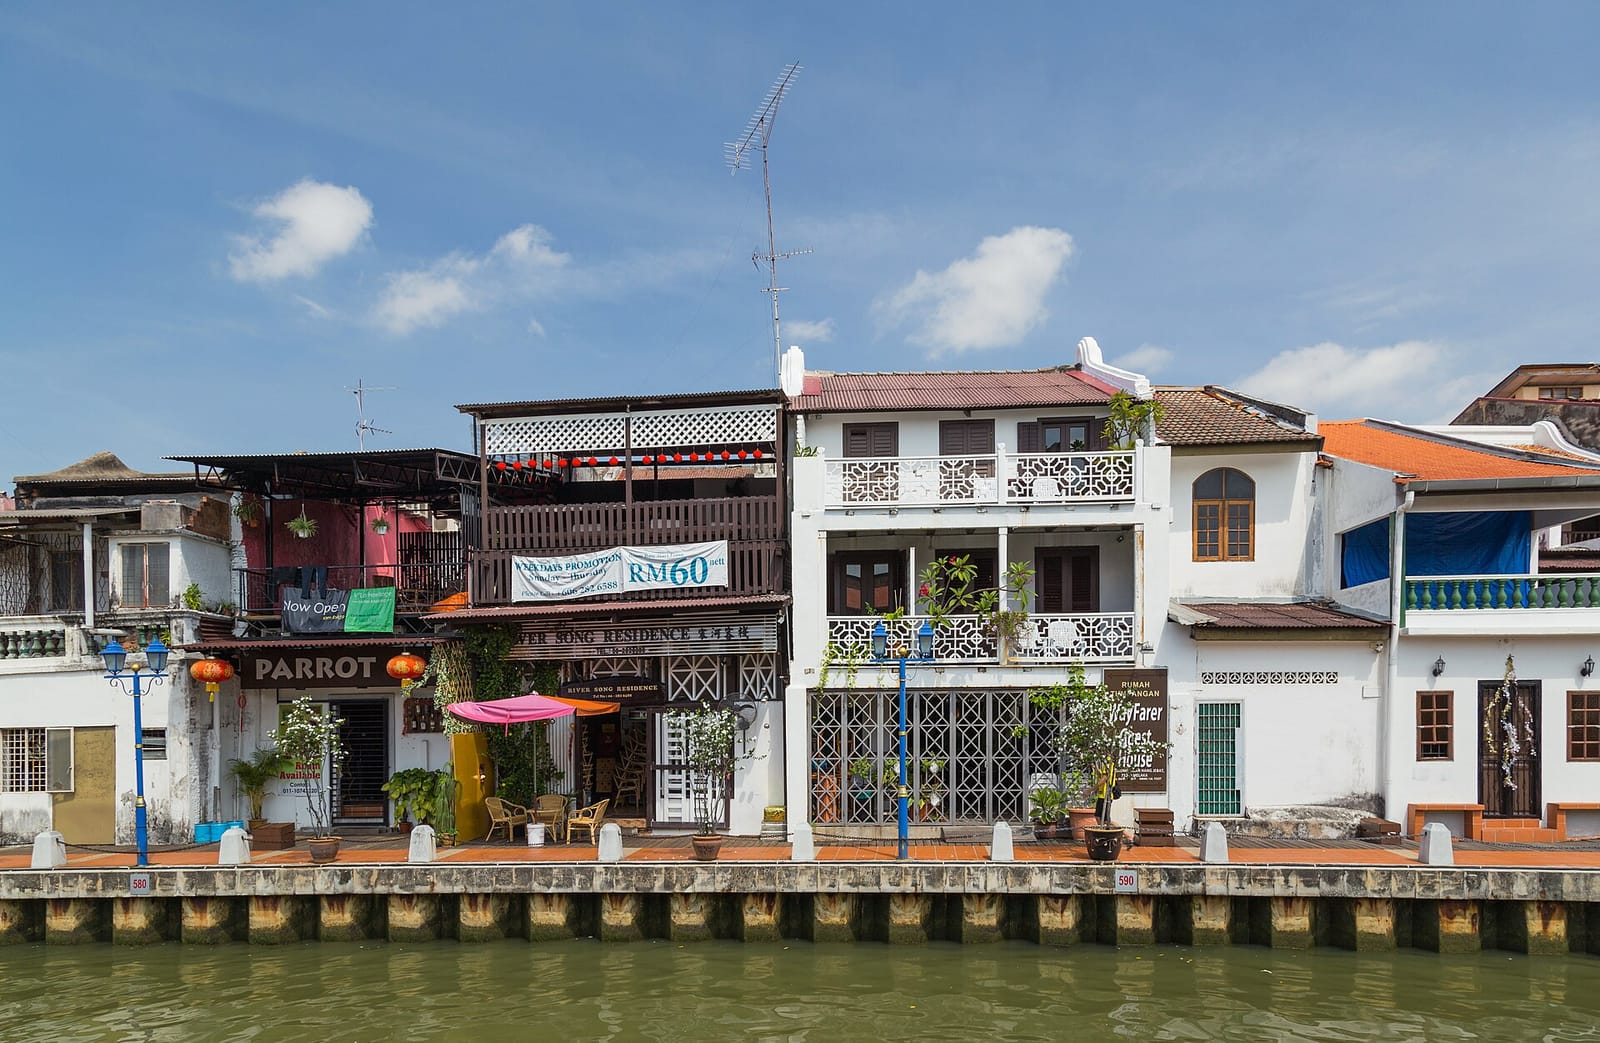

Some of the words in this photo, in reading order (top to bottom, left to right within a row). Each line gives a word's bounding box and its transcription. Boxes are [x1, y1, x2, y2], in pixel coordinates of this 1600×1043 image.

[514, 561, 563, 572] WEEKDAYS
[565, 552, 622, 571] PROMOTION
[709, 558, 725, 566] nett
[596, 581, 618, 590] 6588
[283, 600, 311, 612] Now
[313, 602, 346, 615] Open
[555, 630, 594, 644] SONG
[603, 627, 690, 643] RESIDENCE
[255, 656, 377, 681] PARROT
[567, 686, 591, 694] RIVER
[593, 685, 614, 693] SONG
[616, 683, 659, 692] RESIDENCE
[1121, 681, 1150, 689] RUMAH
[133, 878, 147, 889] 580
[1118, 875, 1134, 886] 590
